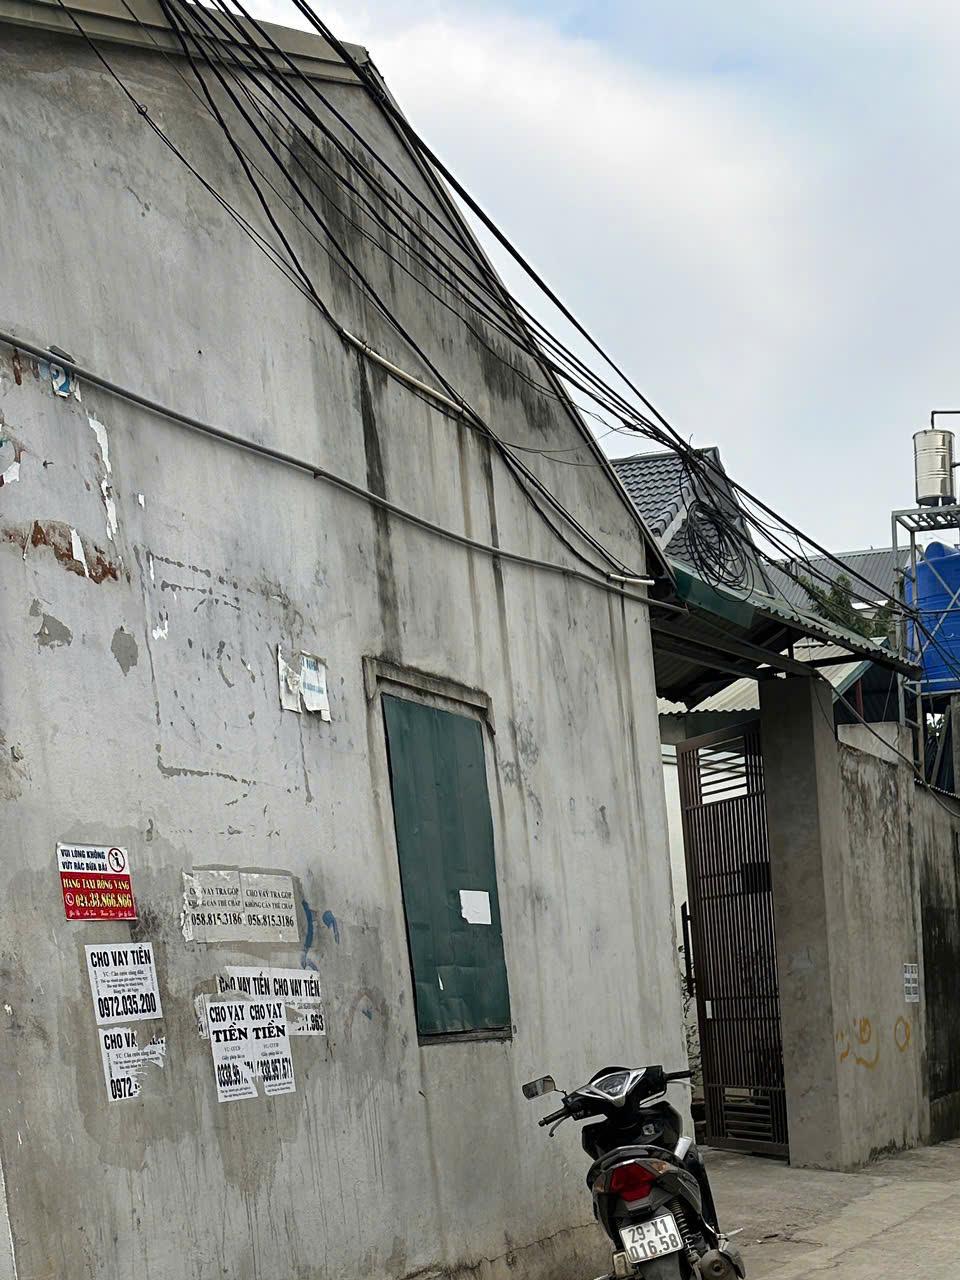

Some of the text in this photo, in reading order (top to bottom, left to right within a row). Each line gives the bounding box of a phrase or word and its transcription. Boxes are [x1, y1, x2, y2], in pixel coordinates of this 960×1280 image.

[90, 951, 110, 967] CHO
[111, 950, 128, 966] VAY
[273, 978, 288, 996] CHO
[289, 978, 303, 996] VAY
[98, 992, 156, 1018] 0972.035.200
[210, 1004, 226, 1023] CHO
[227, 1004, 244, 1022] VAY
[250, 1002, 282, 1020] CHO VAY
[212, 1022, 248, 1043] TIỀN
[252, 1020, 286, 1040] TIỀN
[104, 1034, 123, 1050] CHO
[124, 1032, 138, 1048] VA
[628, 1218, 668, 1244] 29-X1
[629, 1233, 679, 1261] 016.58
